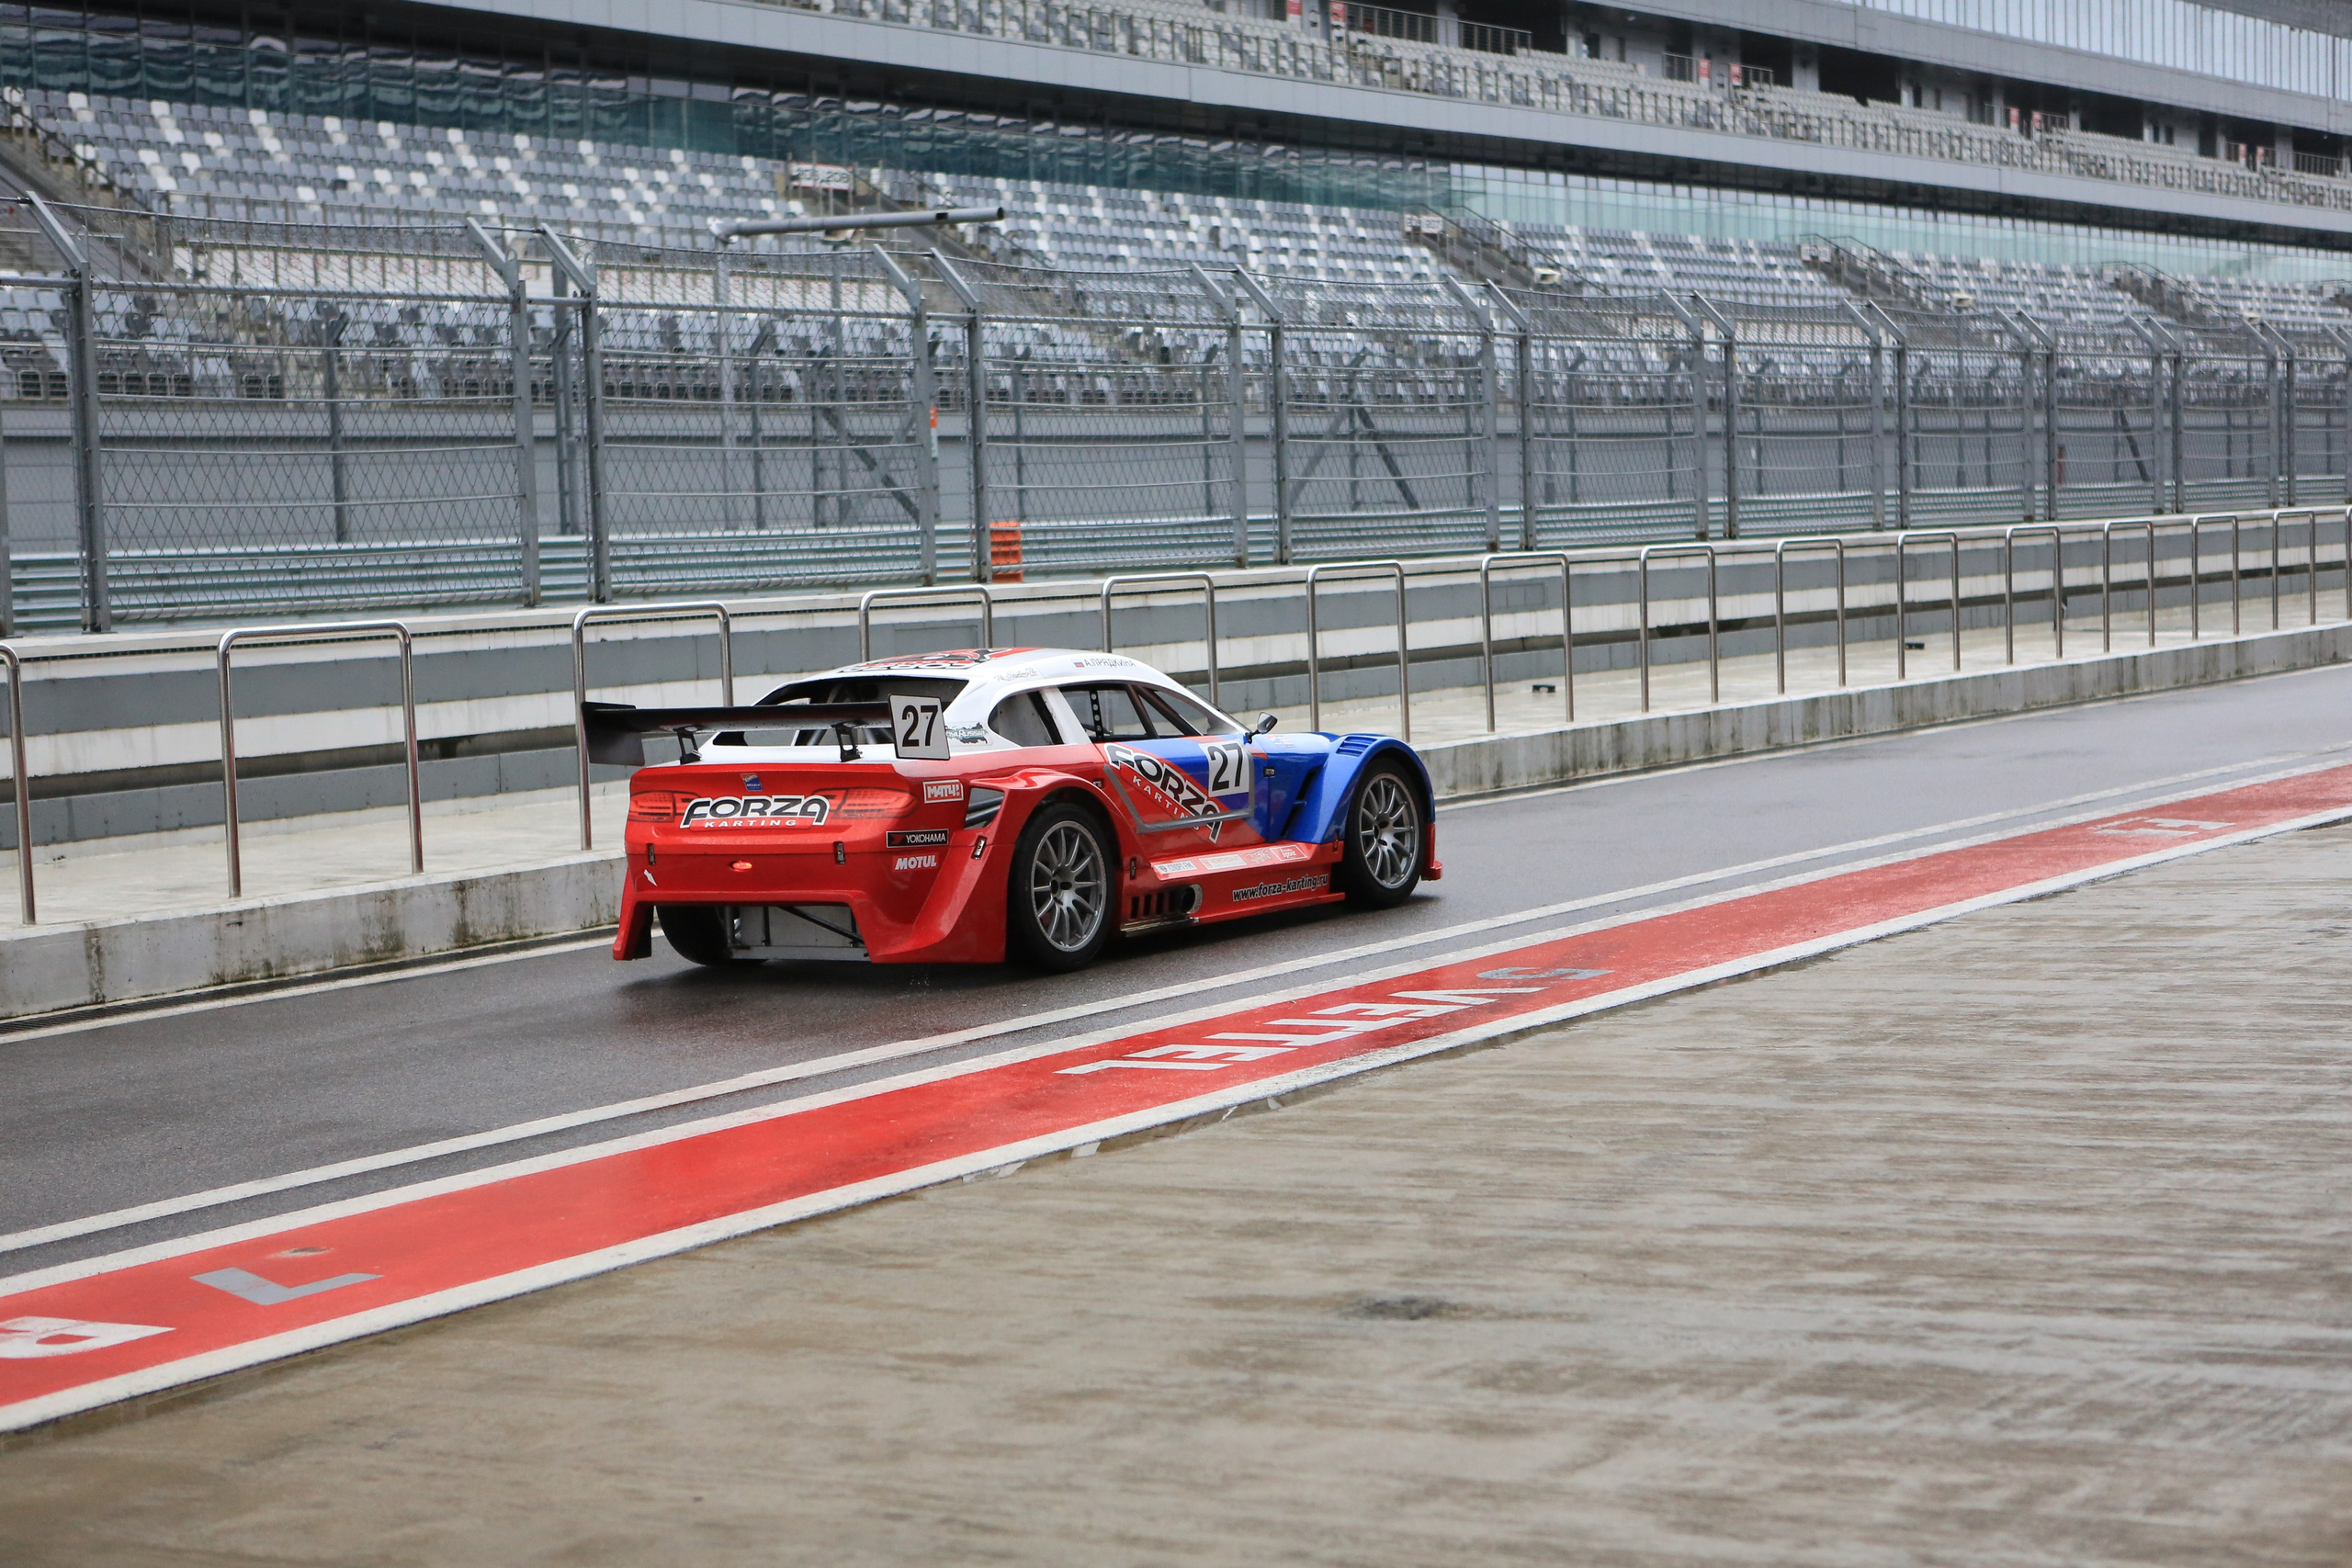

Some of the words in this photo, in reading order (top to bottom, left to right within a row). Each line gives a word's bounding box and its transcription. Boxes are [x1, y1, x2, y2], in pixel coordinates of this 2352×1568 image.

[902, 705, 938, 748] 27
[1206, 742, 1243, 792] 27
[680, 795, 831, 829] FORZA
[704, 819, 797, 829] KARTING
[906, 832, 946, 844] YOKOHAMA
[894, 854, 937, 870] MOTUL
[1233, 874, 1329, 902] www.forza-karting.ru
[1052, 986, 1549, 1075] VETTEL
